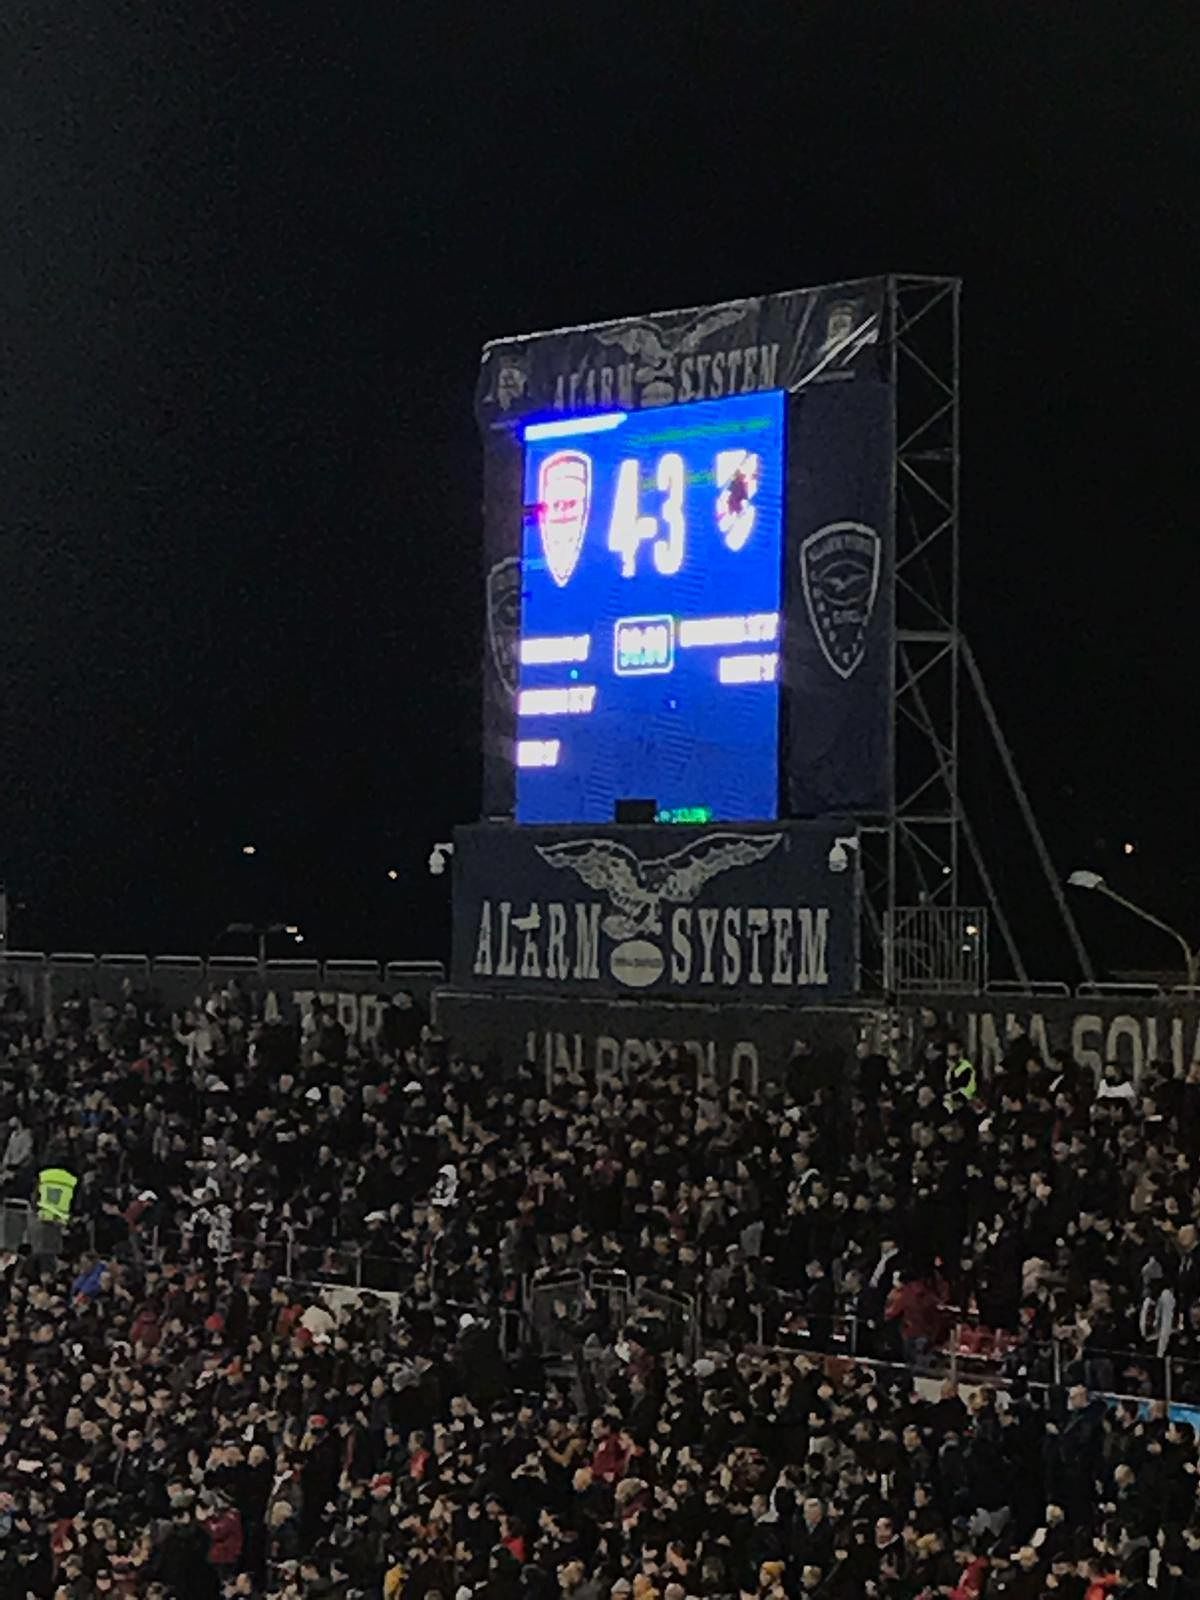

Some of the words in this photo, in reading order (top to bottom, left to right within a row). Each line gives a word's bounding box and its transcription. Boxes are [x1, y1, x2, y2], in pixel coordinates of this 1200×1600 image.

[473, 901, 600, 981] ALARM
[670, 907, 830, 985] SYSTEM
[1071, 1013, 1200, 1095] SQU
